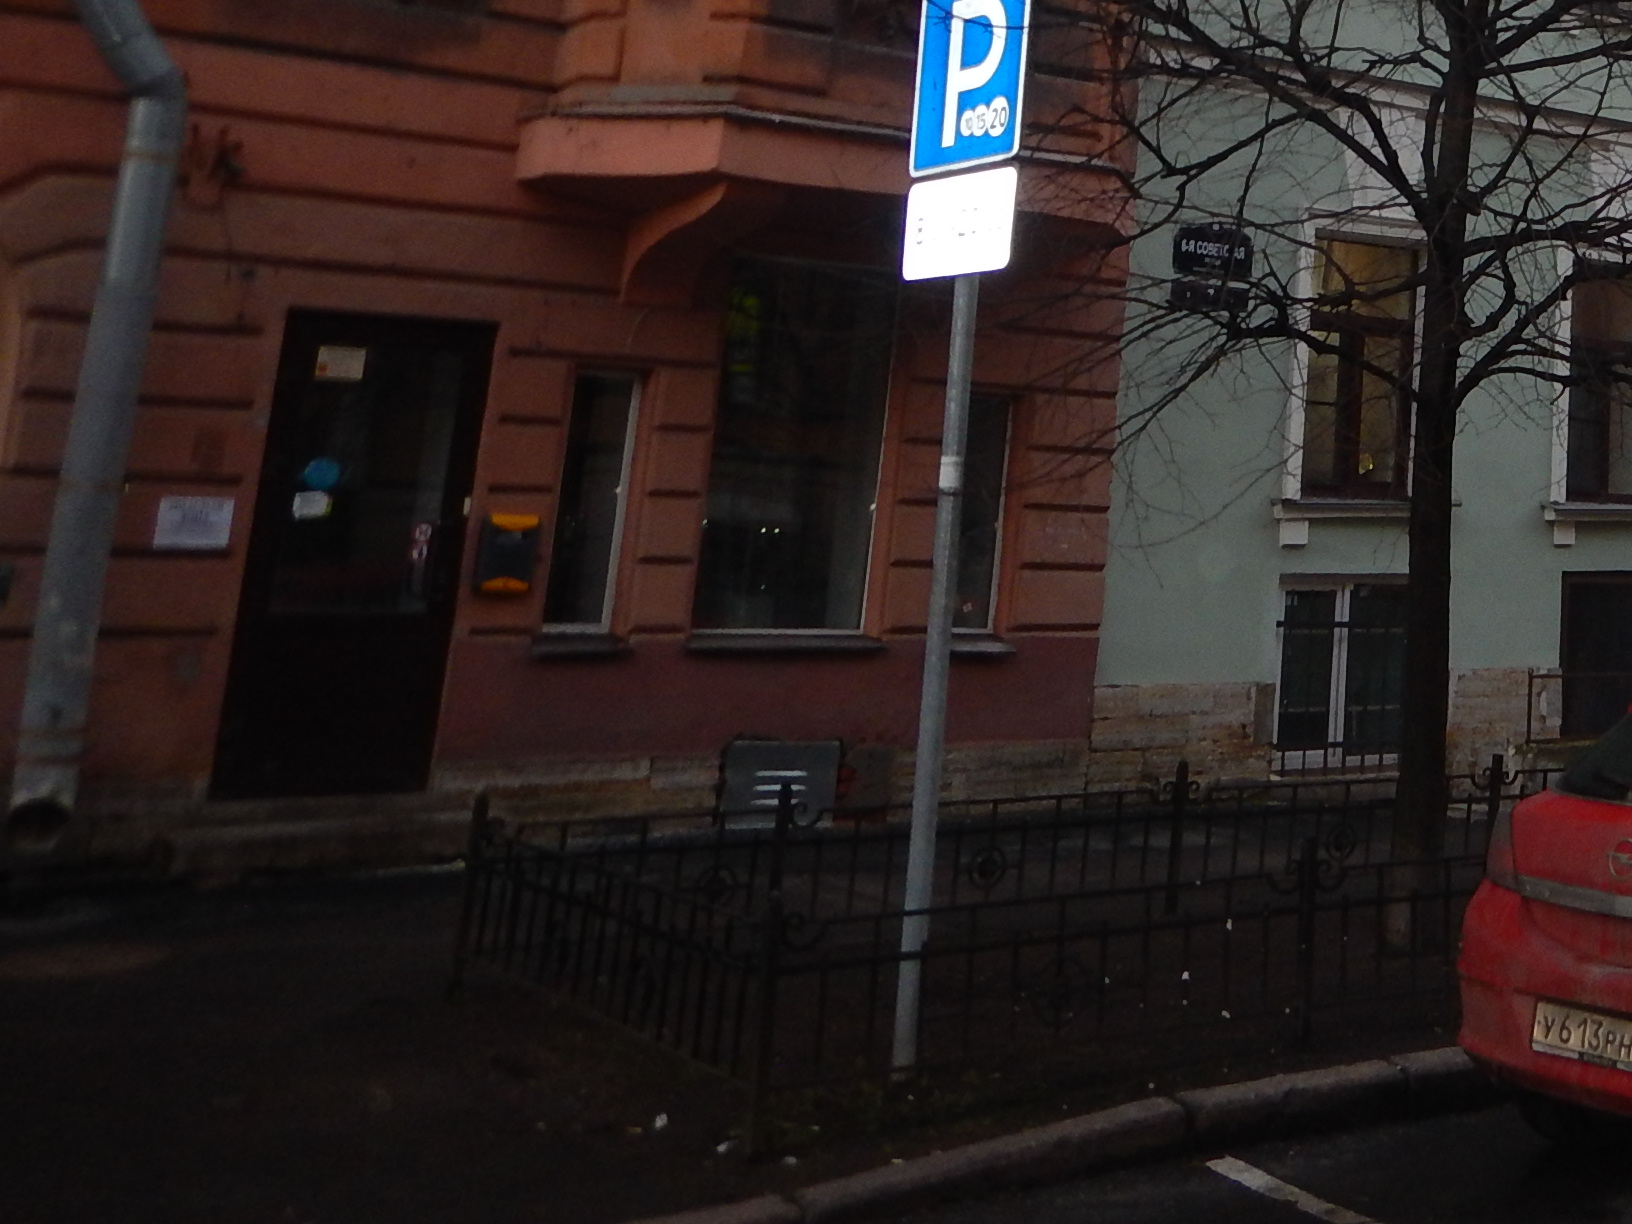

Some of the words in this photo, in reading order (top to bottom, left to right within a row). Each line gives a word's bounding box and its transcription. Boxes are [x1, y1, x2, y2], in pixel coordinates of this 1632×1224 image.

[976, 113, 986, 129] 15
[990, 107, 1007, 129] 20
[1196, 240, 1245, 260] СОВЕТСАЯ
